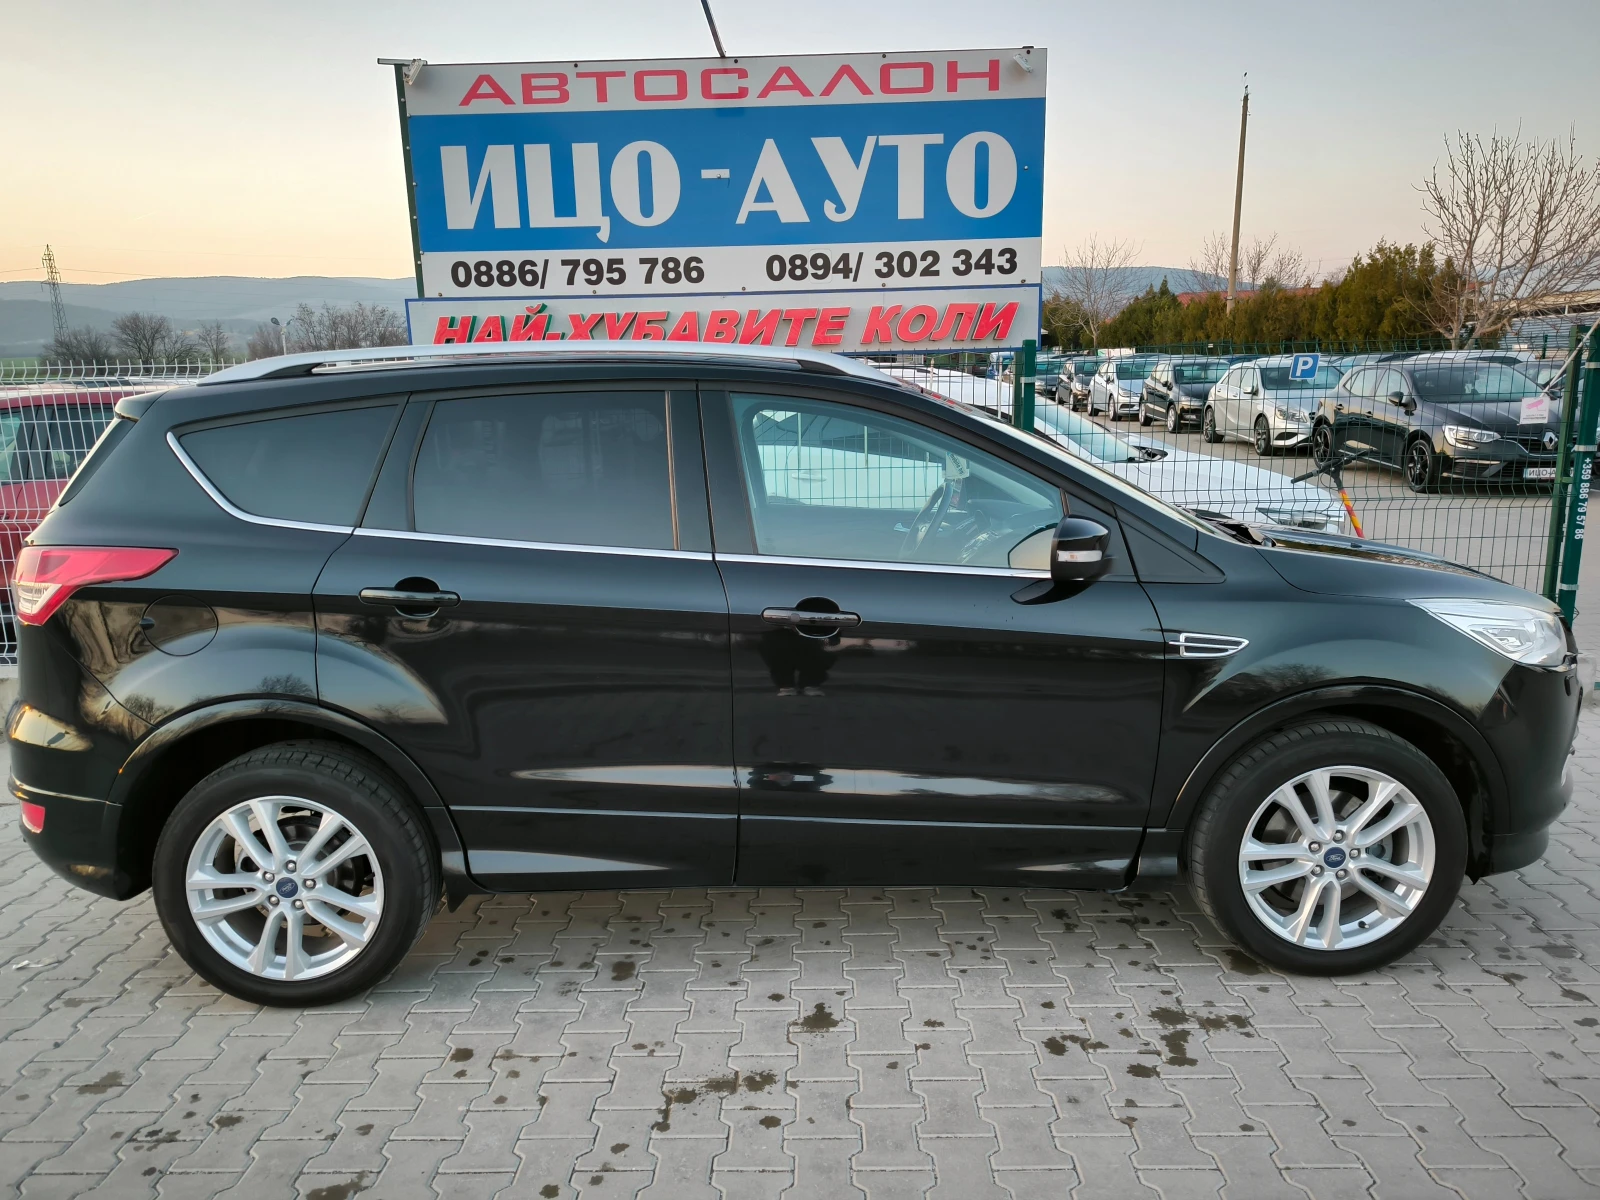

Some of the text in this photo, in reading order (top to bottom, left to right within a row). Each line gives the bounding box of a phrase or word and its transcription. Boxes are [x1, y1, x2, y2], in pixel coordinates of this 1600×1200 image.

[458, 59, 1000, 107] АВТОСАЛОН
[451, 256, 705, 289] 0886/ 795 786
[766, 247, 1018, 282] 0894/ 302 343
[860, 301, 1020, 344] КОЛИ
[1296, 357, 1313, 376] P
[1574, 457, 1592, 540] +359 886 79 57 86
